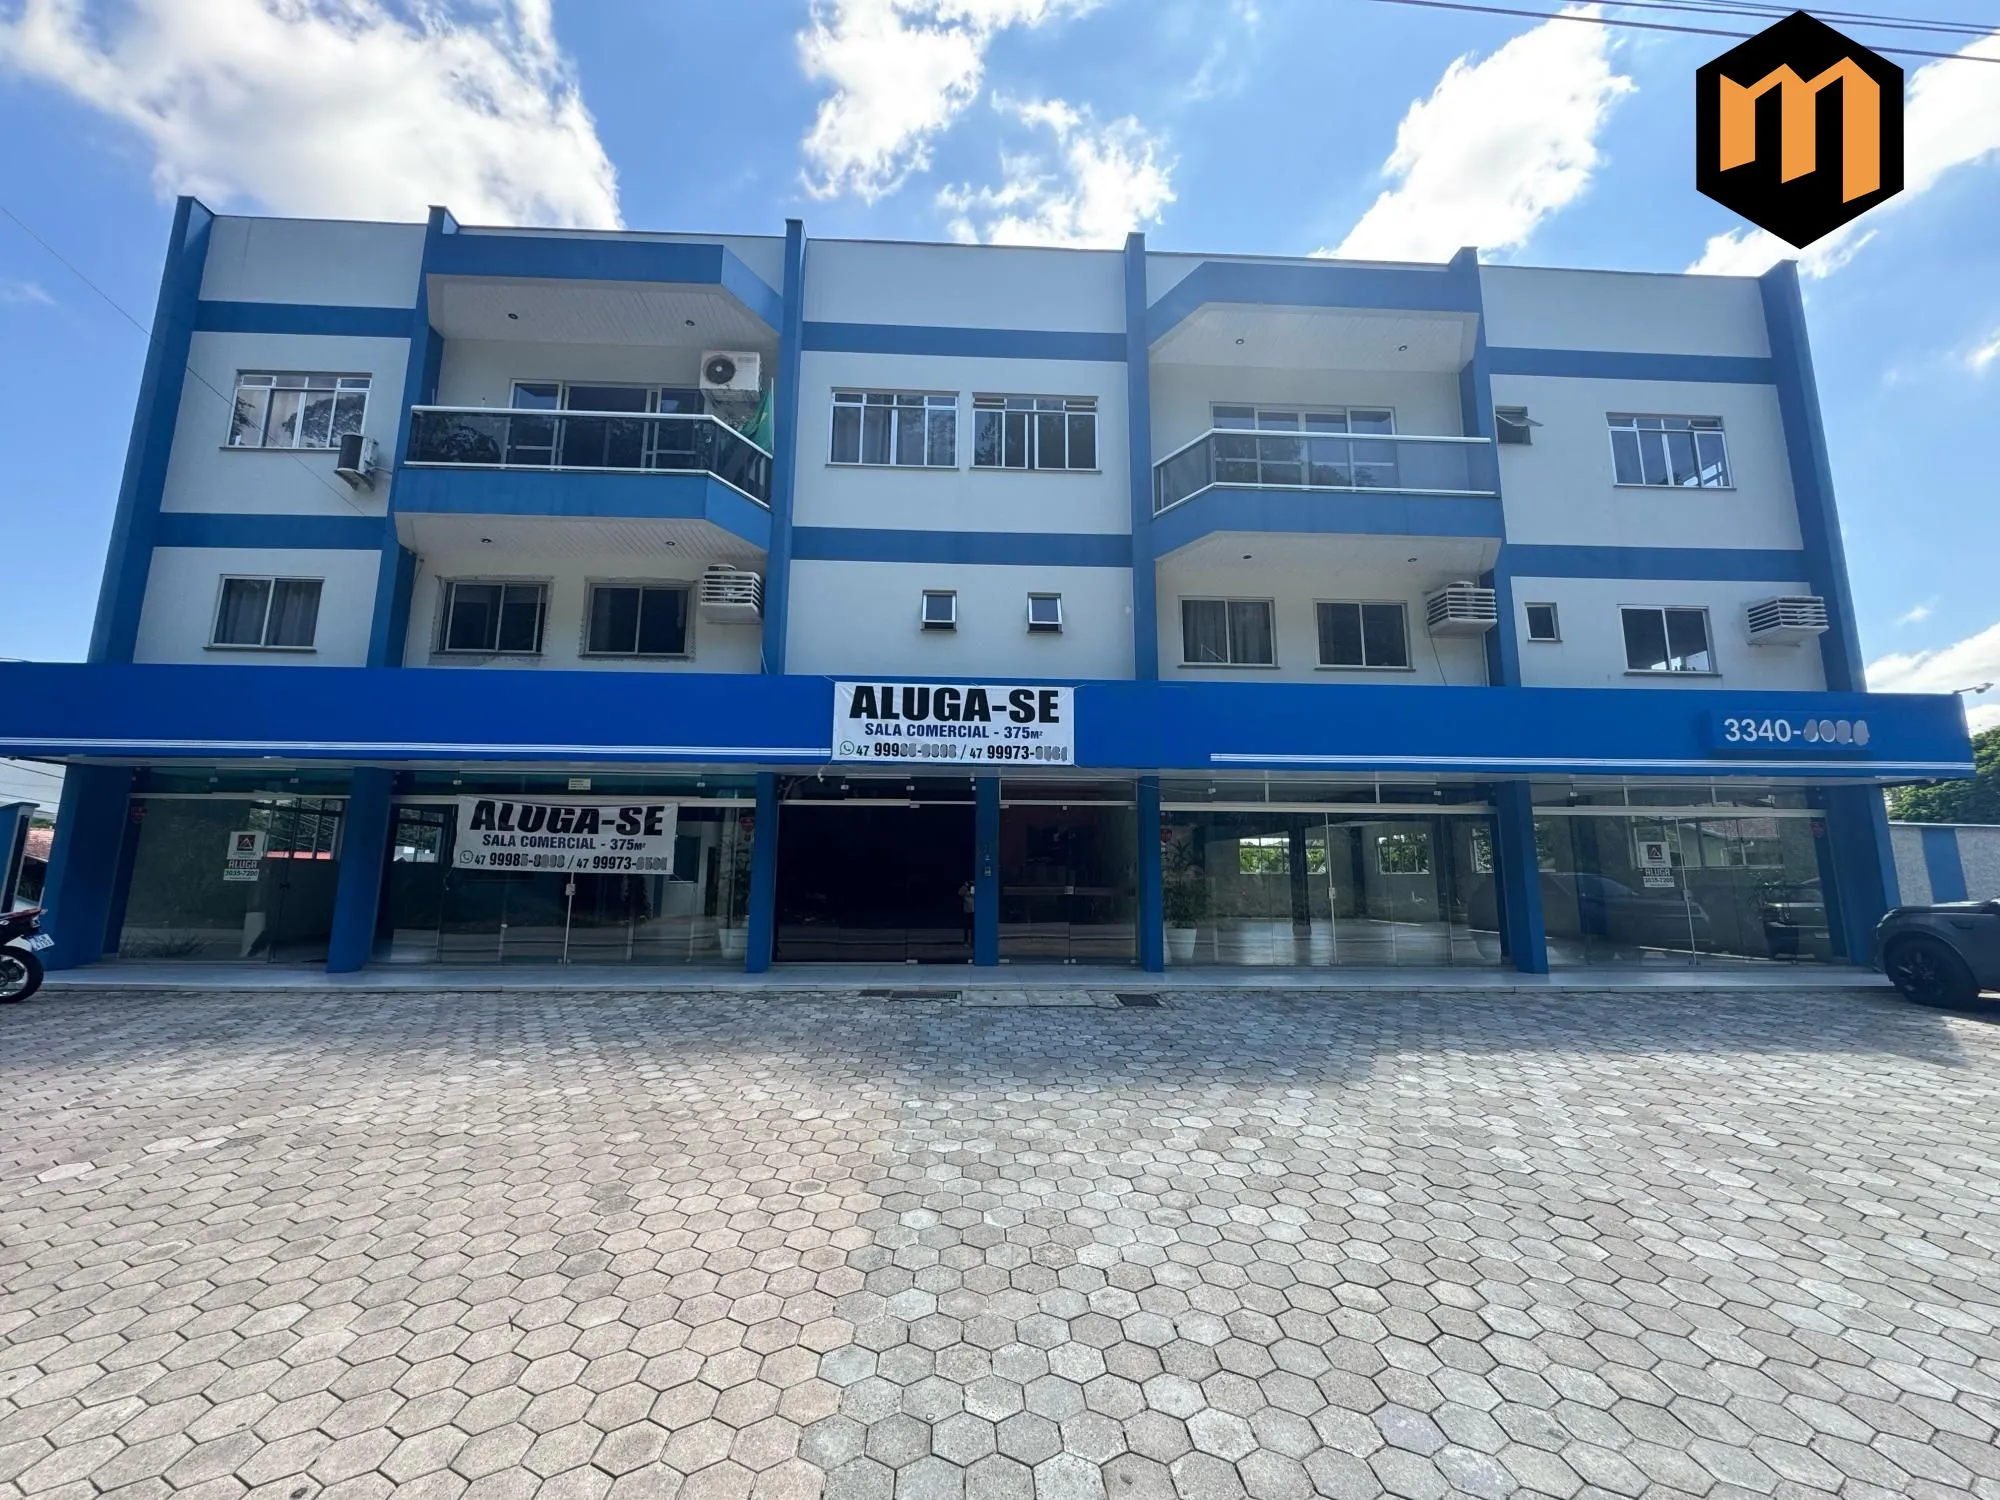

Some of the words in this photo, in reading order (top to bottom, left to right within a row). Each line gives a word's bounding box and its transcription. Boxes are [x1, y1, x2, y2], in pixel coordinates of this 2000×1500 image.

[849, 685, 1060, 724] ALUGA-SE
[865, 722, 901, 737] SALA
[906, 724, 989, 739] COMERCIAL
[1724, 718, 1870, 746] 3340-
[856, 744, 869, 756] 47
[969, 747, 982, 760] 47
[987, 745, 1068, 762] 99973-
[469, 800, 665, 836] ALUGA-SE
[482, 834, 516, 847] SALA
[520, 835, 596, 850] COMERCIAL
[228, 860, 257, 869] ALUGA
[474, 854, 486, 865] 47
[576, 858, 588, 869] 47
[592, 855, 667, 871] 99973-
[1645, 868, 1671, 876] ALUGA
